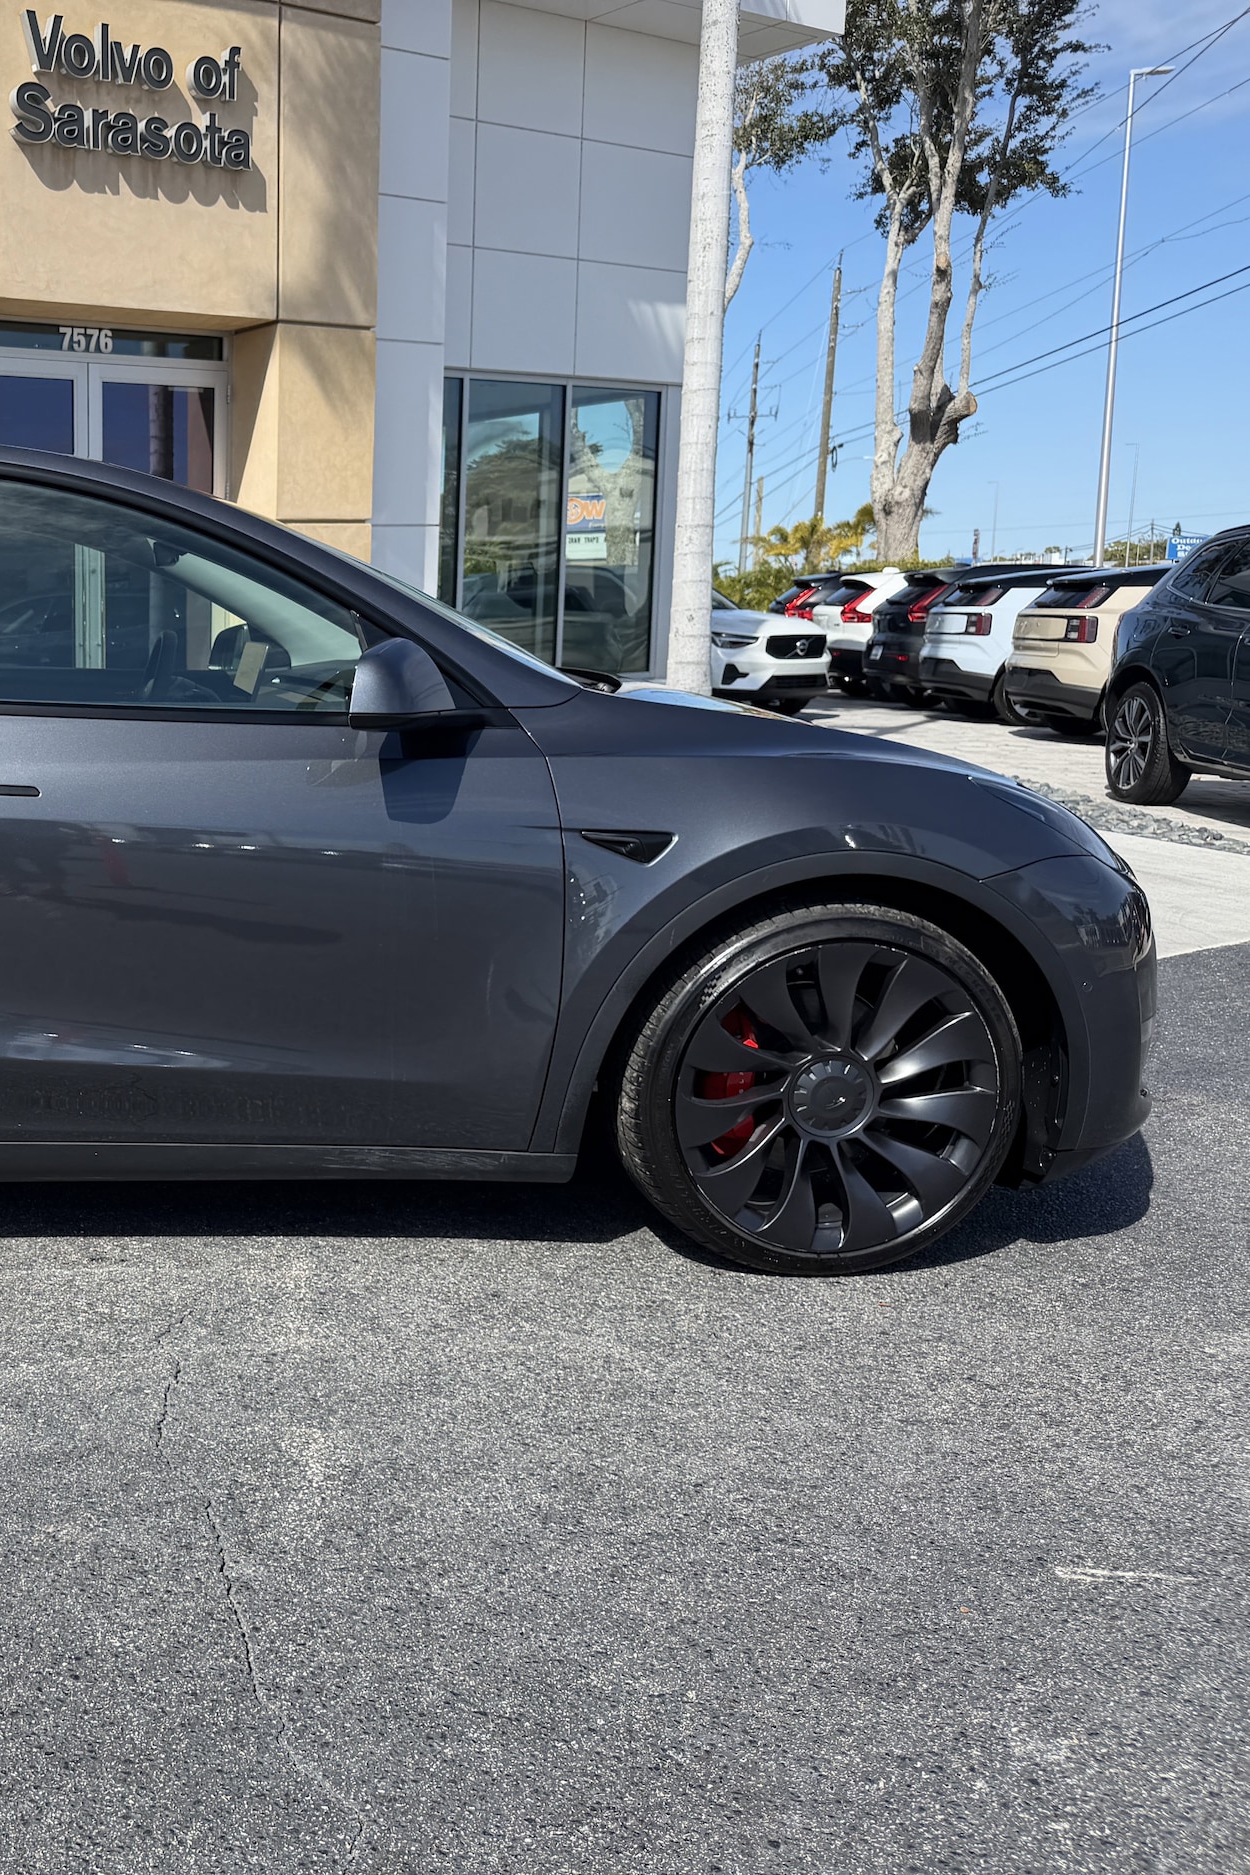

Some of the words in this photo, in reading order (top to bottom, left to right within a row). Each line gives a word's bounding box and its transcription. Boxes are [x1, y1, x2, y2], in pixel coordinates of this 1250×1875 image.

[21, 9, 174, 90] Volvo
[186, 46, 242, 100] of
[9, 81, 252, 170] Sarasota
[59, 326, 113, 354] 7576
